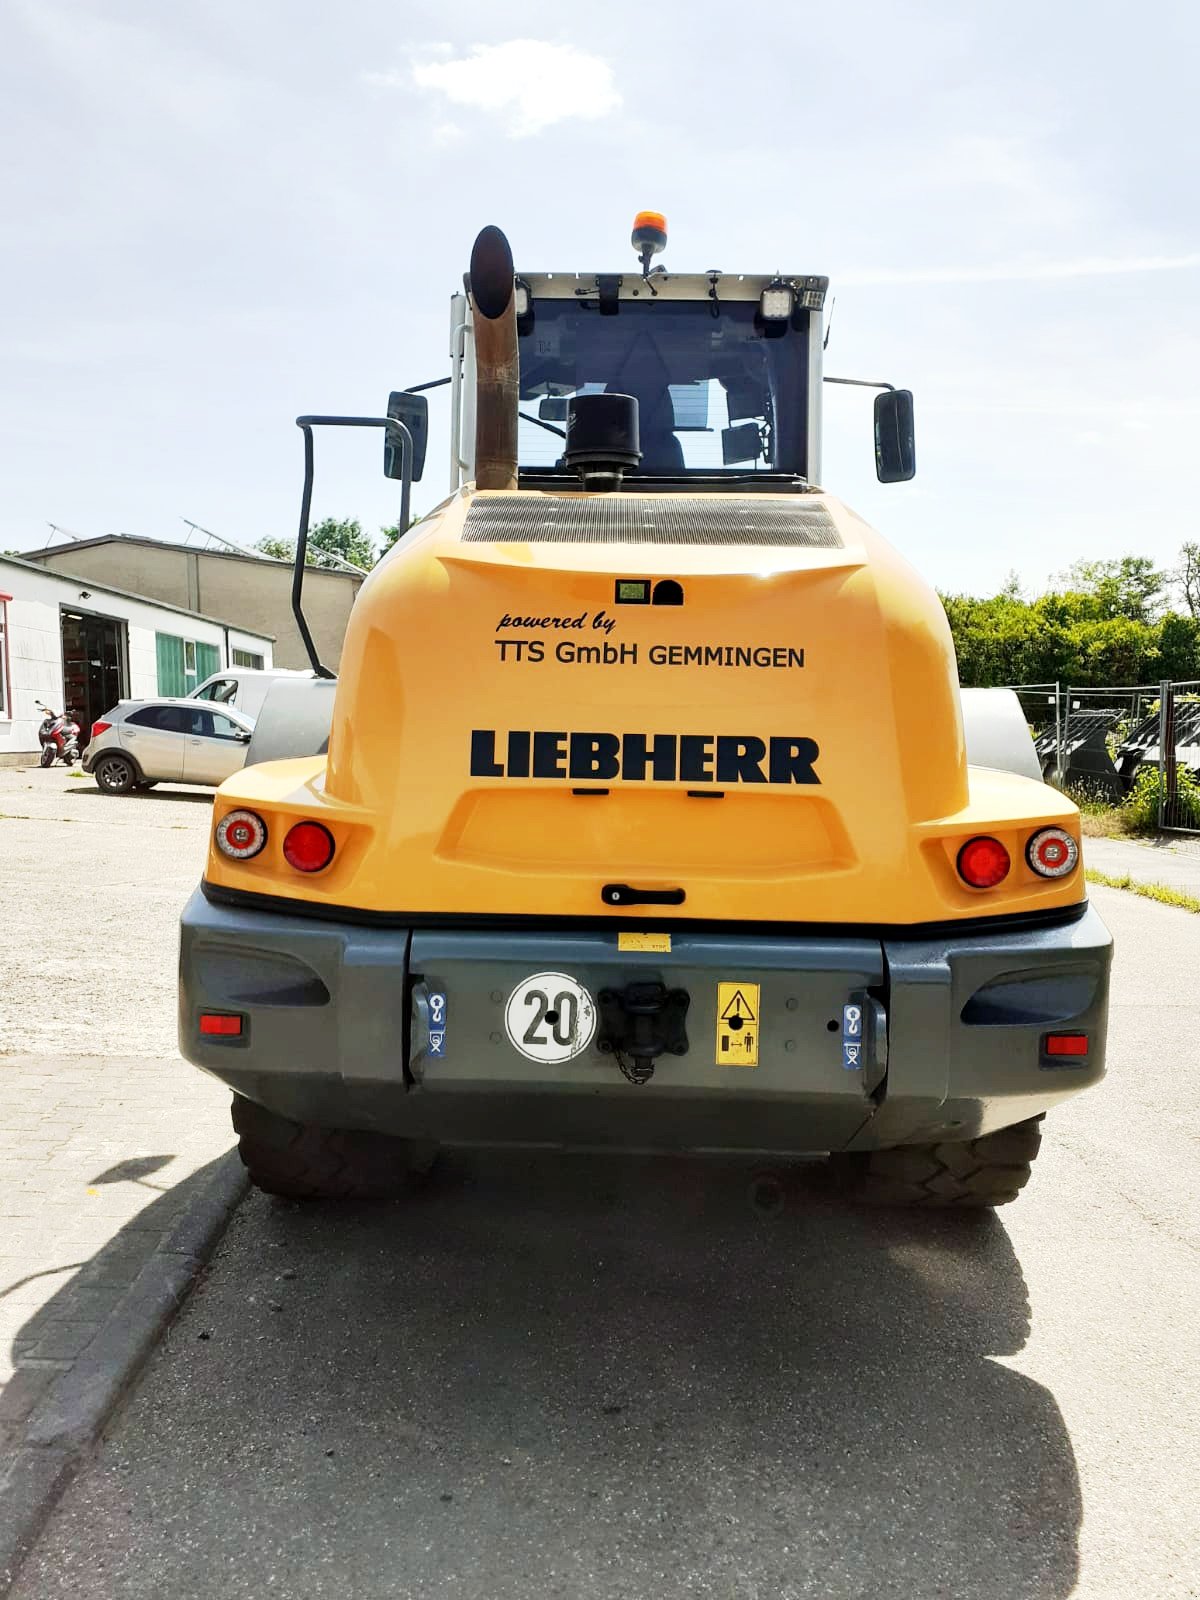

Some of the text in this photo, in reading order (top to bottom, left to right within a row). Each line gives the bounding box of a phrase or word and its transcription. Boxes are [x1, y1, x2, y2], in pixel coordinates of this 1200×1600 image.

[496, 610, 616, 634] powered by
[495, 640, 805, 667] TTS GmbH GEMMINGEN
[470, 730, 822, 784] LIEBHERR
[523, 989, 578, 1046] 20
